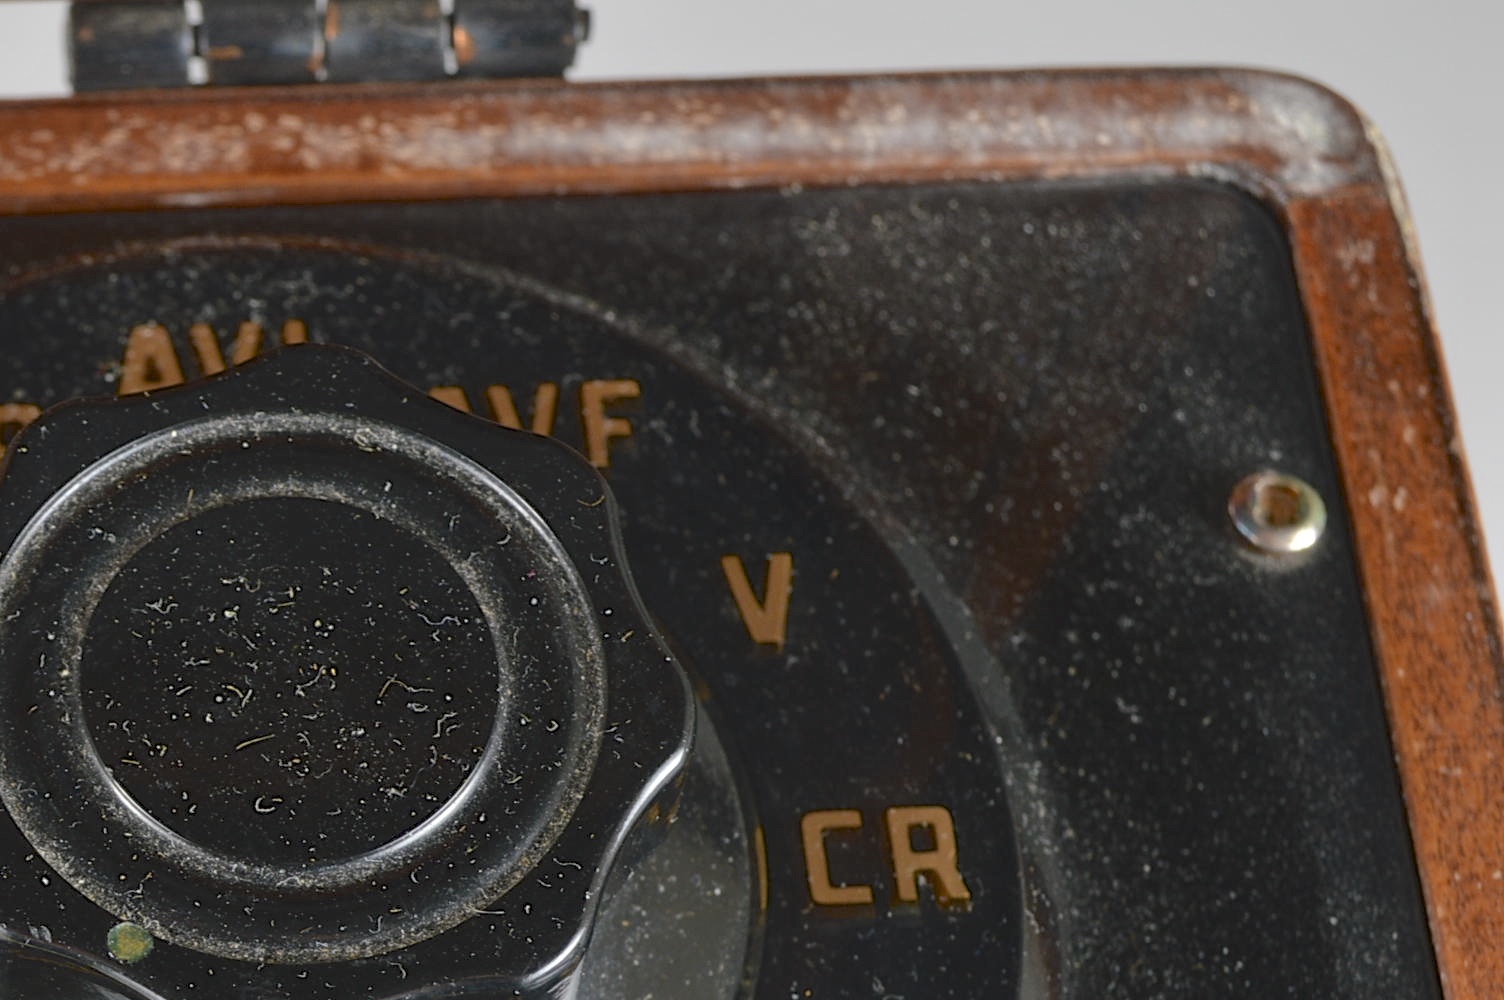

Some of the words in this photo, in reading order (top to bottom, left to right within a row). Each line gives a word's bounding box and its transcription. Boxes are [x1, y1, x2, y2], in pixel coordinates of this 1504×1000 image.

[118, 320, 310, 396] AV
[720, 553, 792, 650] V
[801, 806, 971, 909] CR
